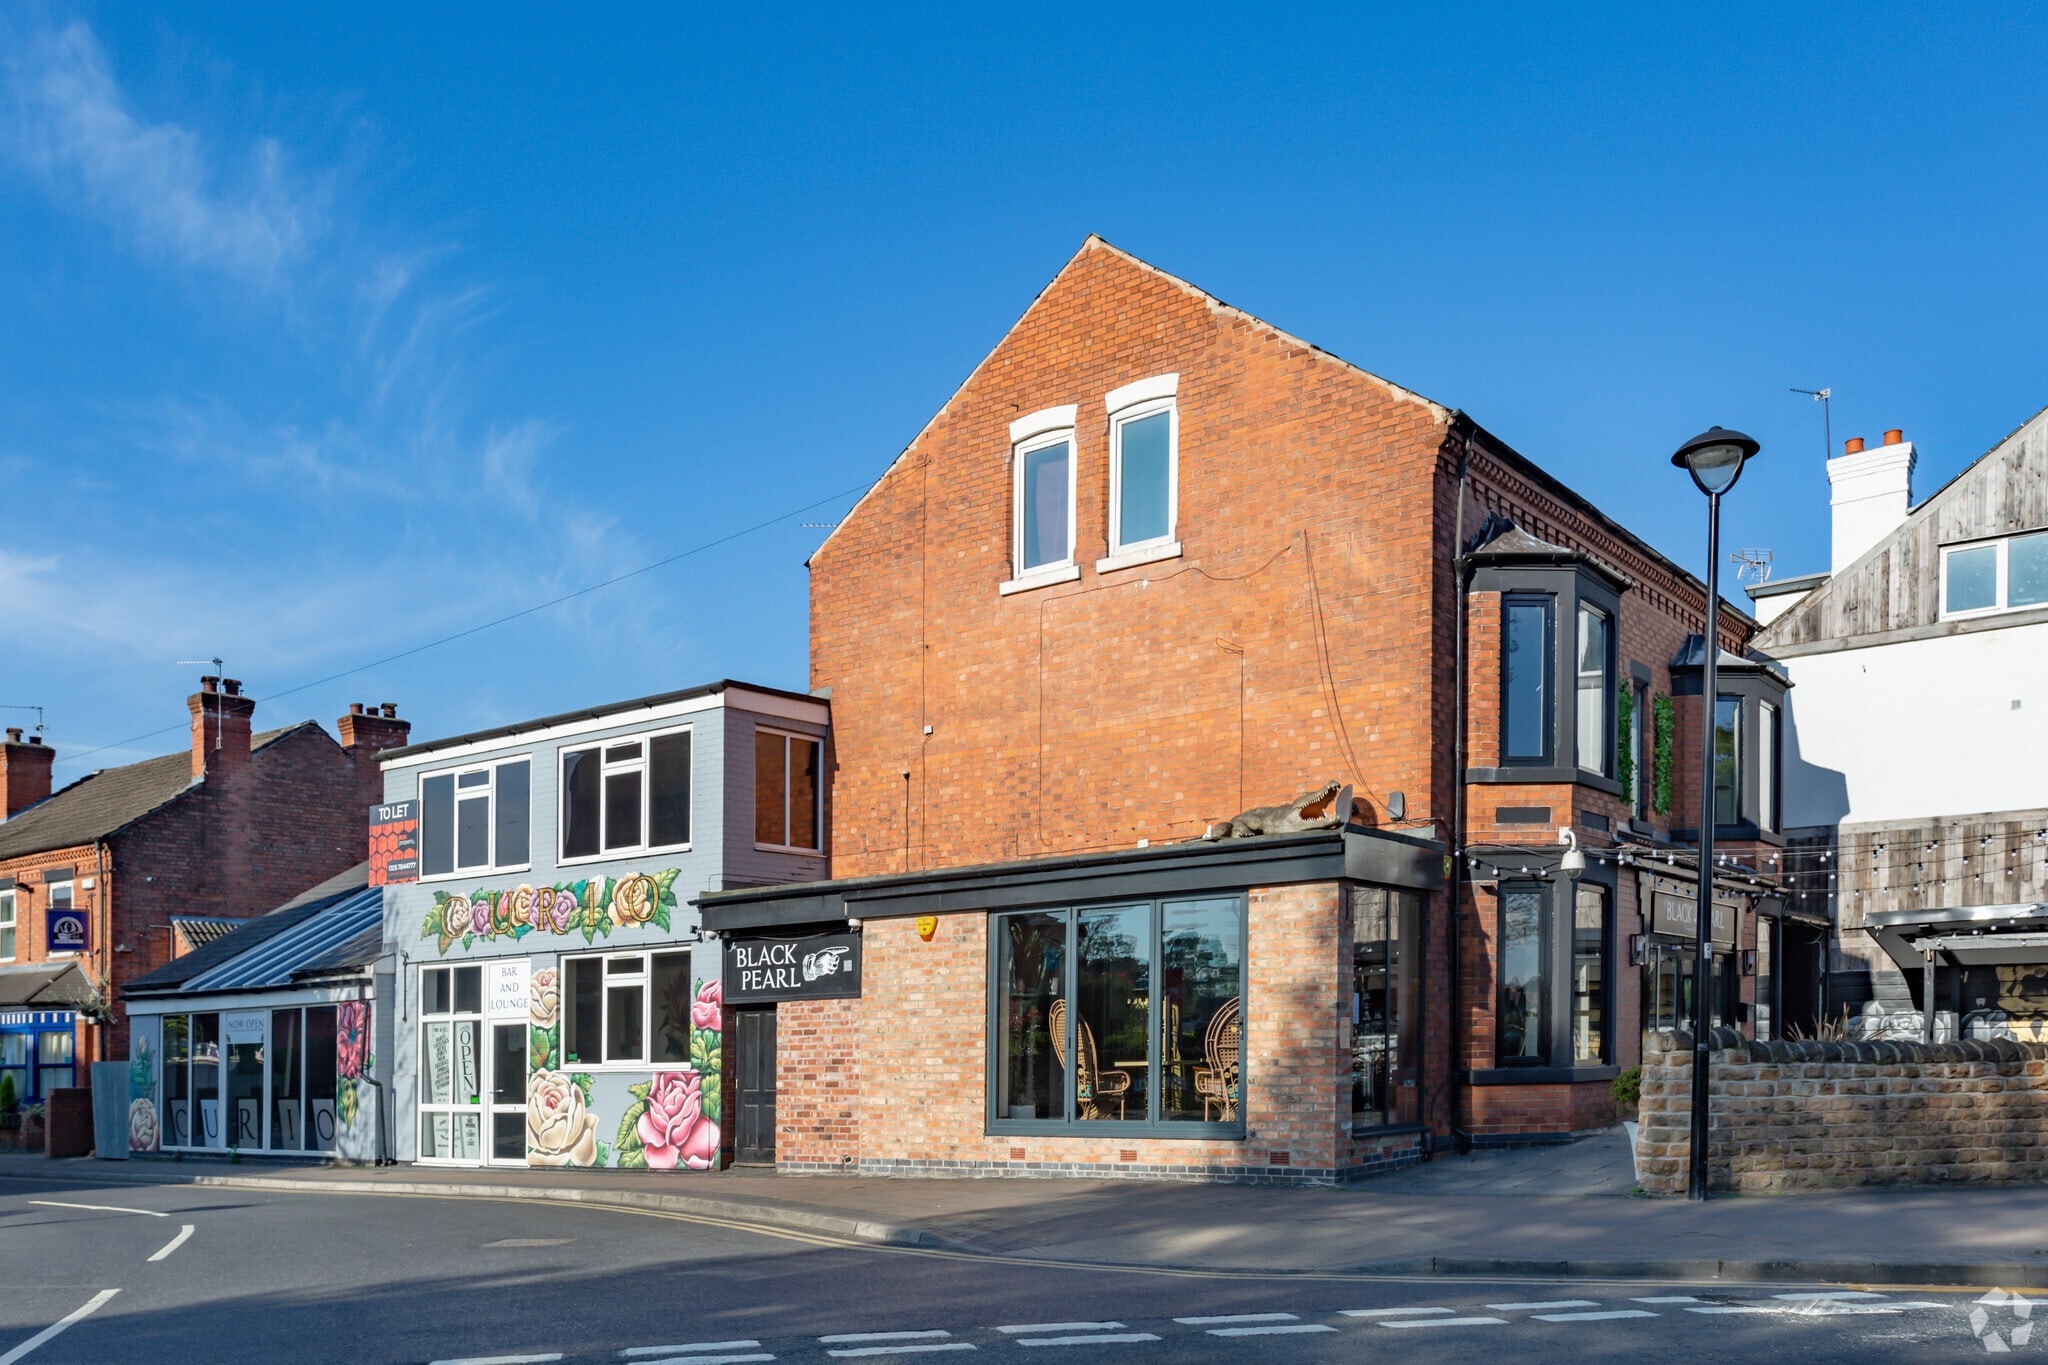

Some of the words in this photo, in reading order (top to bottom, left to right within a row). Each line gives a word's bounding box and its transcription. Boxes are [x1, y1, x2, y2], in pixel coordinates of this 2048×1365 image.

[378, 806, 391, 821] TO
[391, 803, 409, 819] LET
[440, 875, 660, 939] CURIO
[1666, 901, 1692, 923] BLACK
[736, 943, 799, 968] BLACK
[501, 966, 518, 977] BAR
[741, 967, 802, 991] PEARL
[500, 982, 519, 993] AND
[490, 997, 529, 1010] LOUNGE
[228, 1020, 244, 1029] NOW
[245, 1018, 264, 1029] OPEN
[460, 1029, 474, 1091] OPEN
